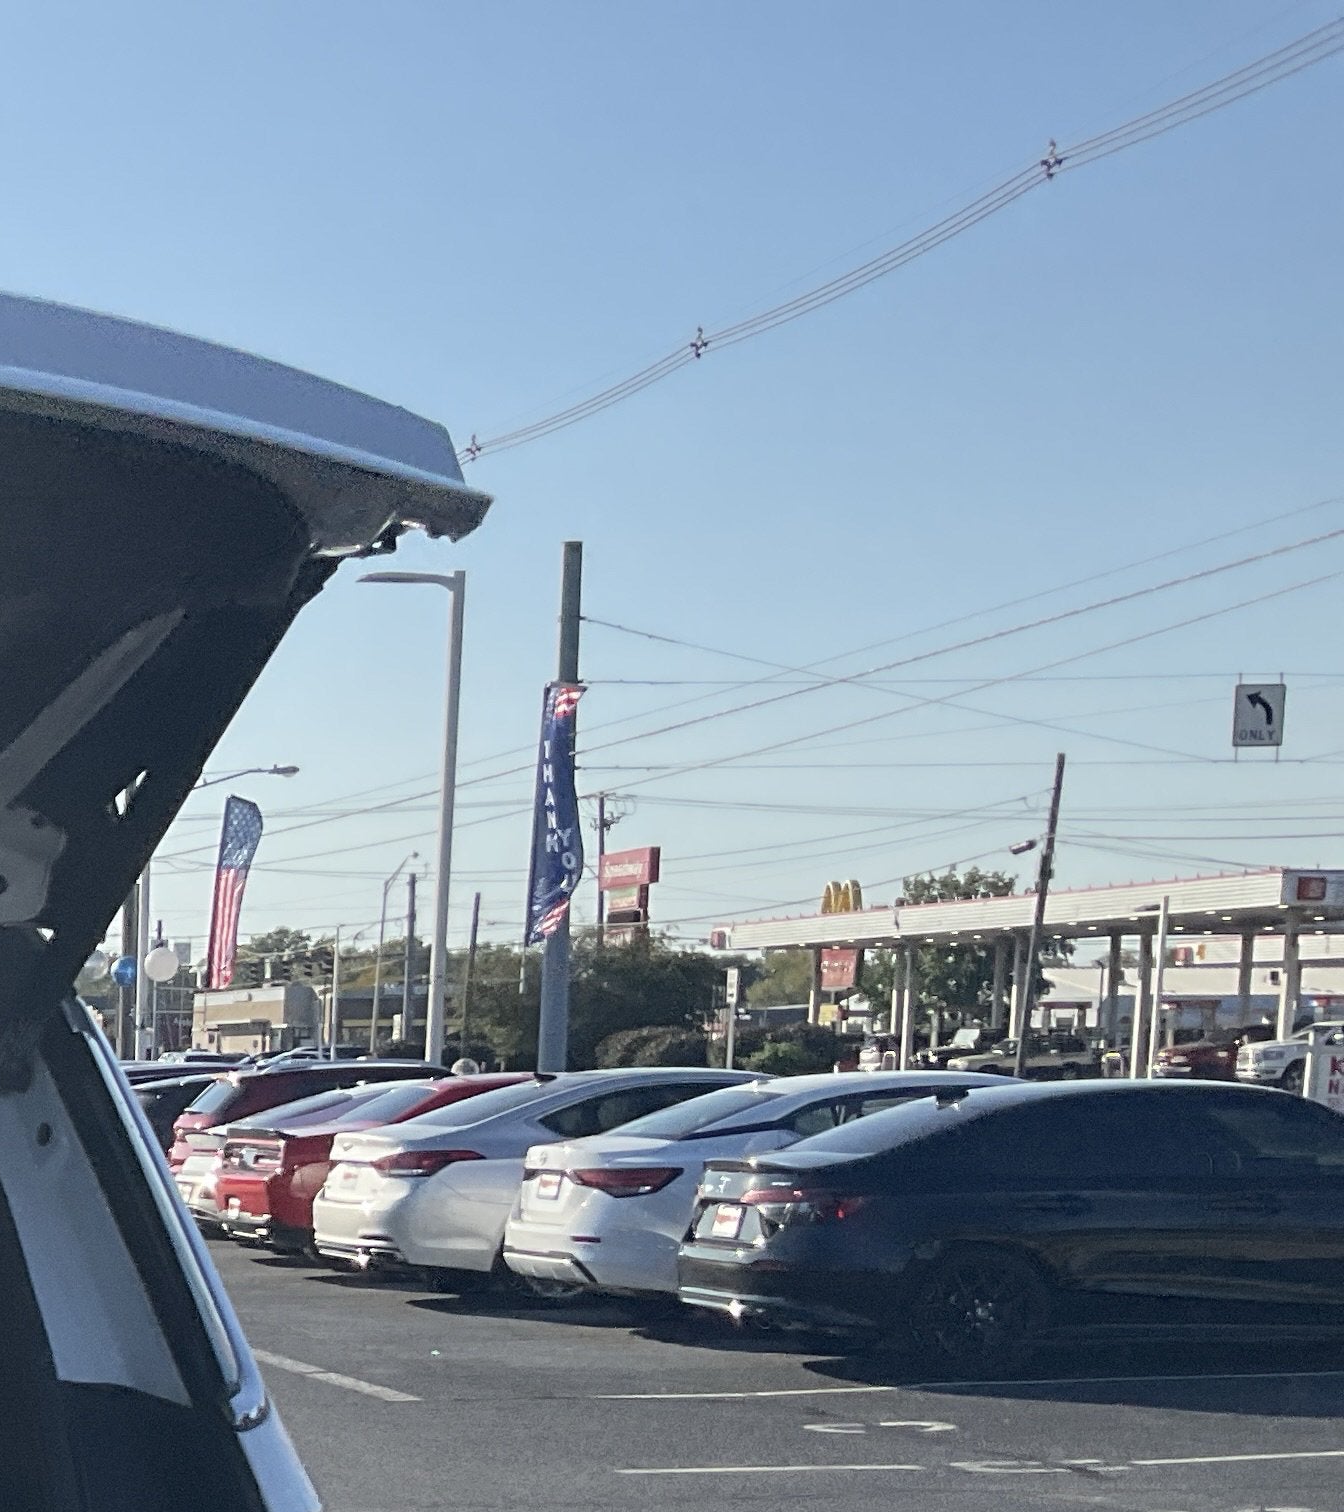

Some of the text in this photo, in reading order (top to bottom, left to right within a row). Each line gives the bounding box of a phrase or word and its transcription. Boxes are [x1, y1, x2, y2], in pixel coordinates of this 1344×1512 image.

[1238, 729, 1276, 741] ONLY
[542, 739, 559, 853] THANK
[557, 827, 578, 891] YOU
